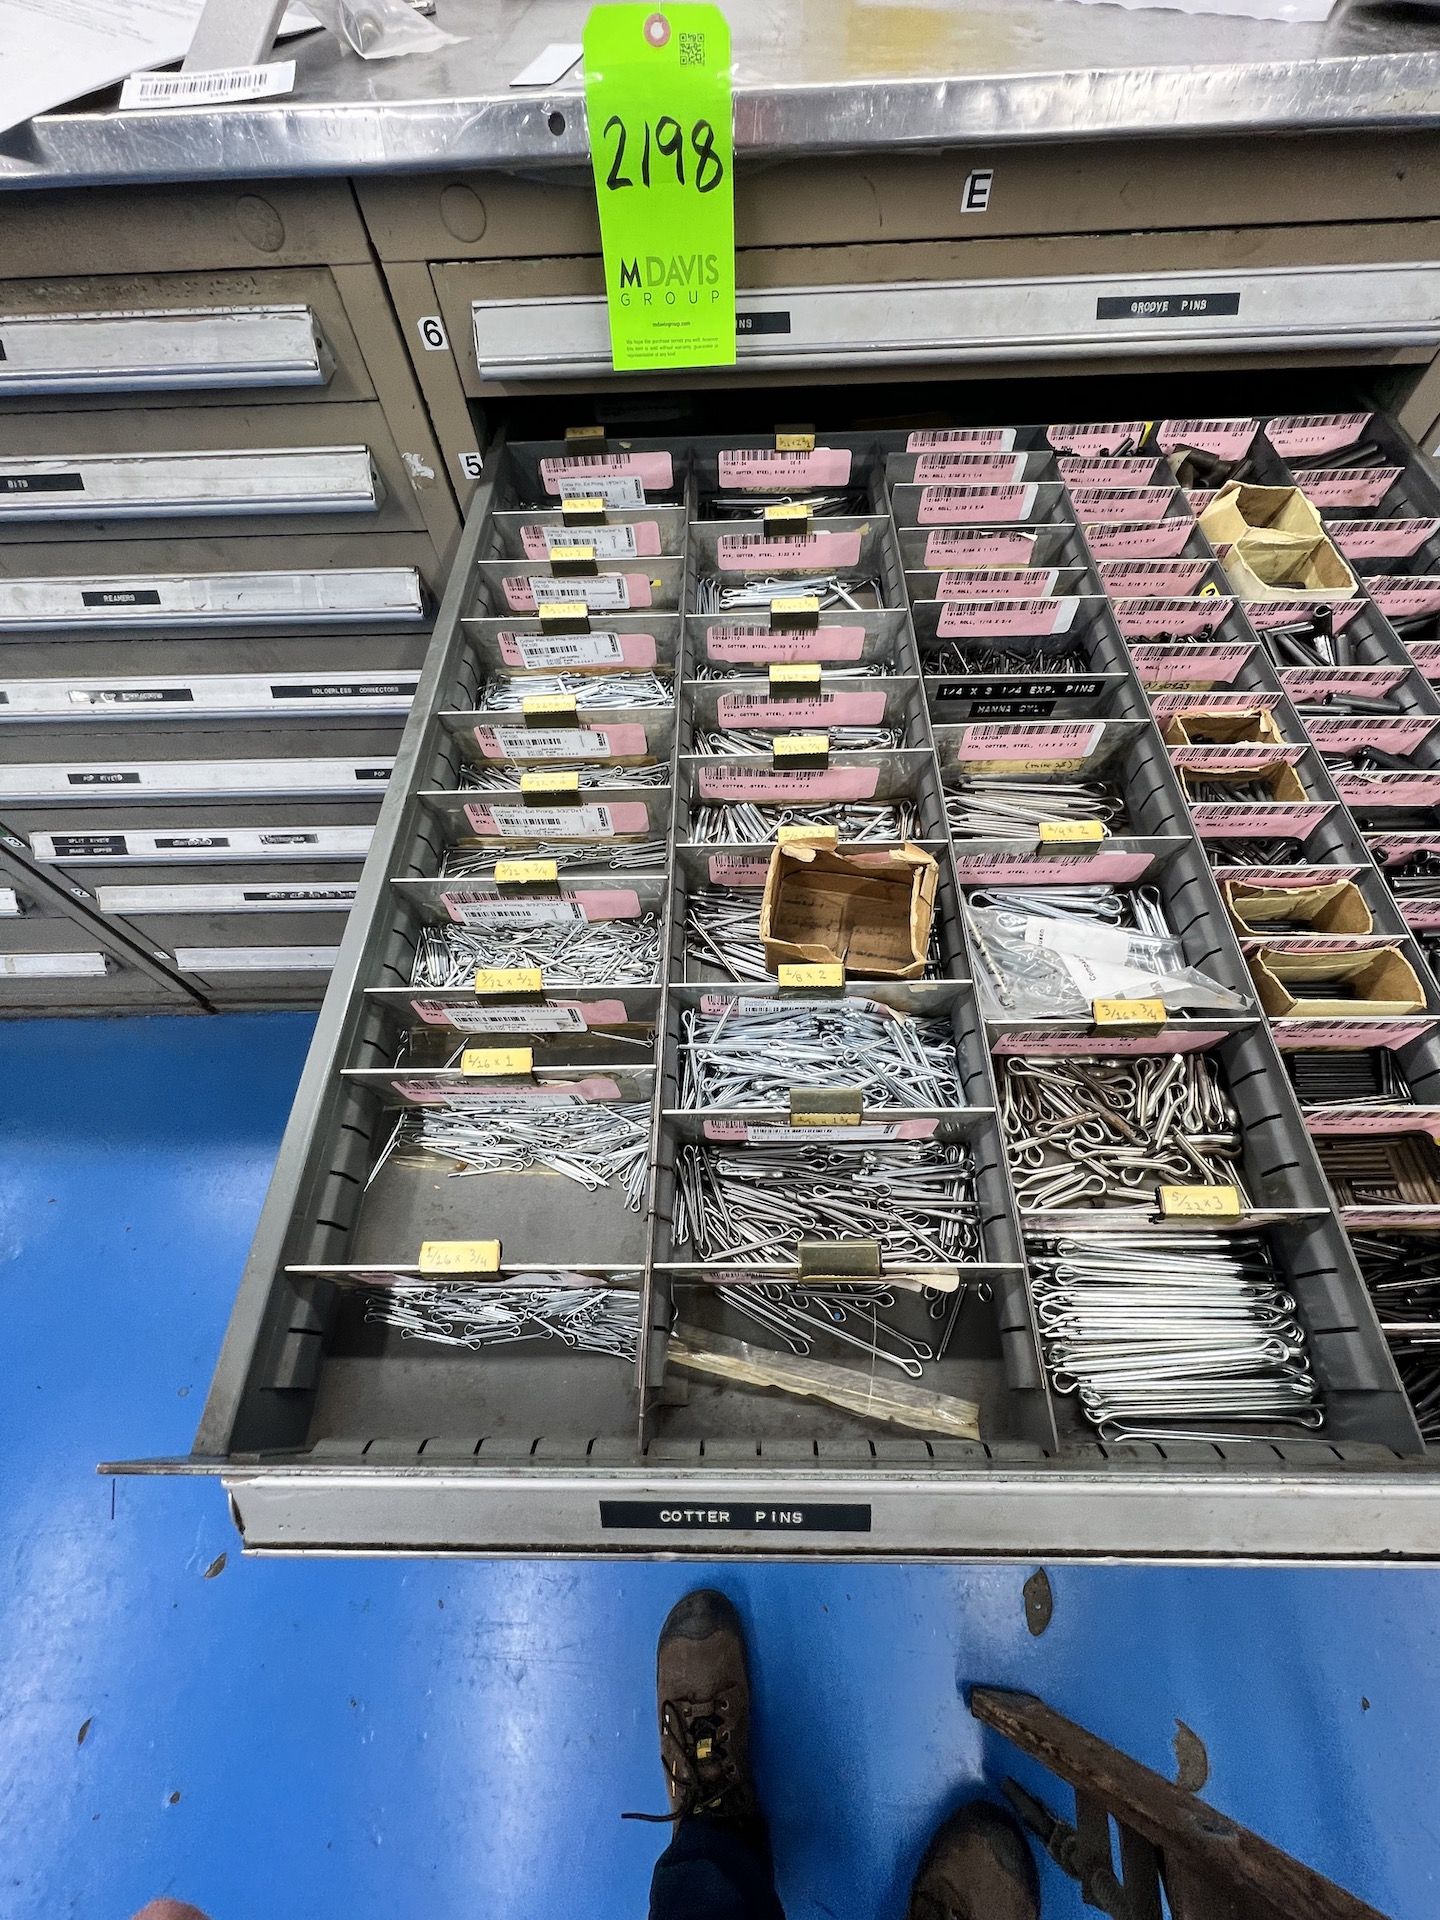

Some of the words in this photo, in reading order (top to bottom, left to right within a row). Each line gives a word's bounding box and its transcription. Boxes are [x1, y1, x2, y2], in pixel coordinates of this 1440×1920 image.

[603, 115, 724, 193] 2198
[967, 173, 992, 209] E
[620, 290, 720, 307] GROUP
[1131, 300, 1169, 314] GROOVE
[1181, 299, 1207, 311] PINS
[733, 318, 753, 329] INS
[423, 320, 443, 347] 6
[465, 455, 483, 476] 5
[103, 594, 136, 603] REAMERS
[311, 687, 352, 695] SOLDERLESS
[359, 686, 399, 694] CONNECTORS
[943, 687, 963, 696] 1/4
[970, 687, 979, 695] X
[984, 687, 992, 695] 3
[1002, 685, 1022, 694] 1/4
[1029, 685, 1056, 694] EXP.
[1065, 684, 1096, 693] PINS
[1019, 704, 1046, 713] CYL.
[1079, 826, 1089, 835] 2
[819, 970, 827, 980] 2
[1212, 1195, 1223, 1210] 3
[659, 1510, 730, 1523] COTTER
[755, 1511, 803, 1523] PINS
